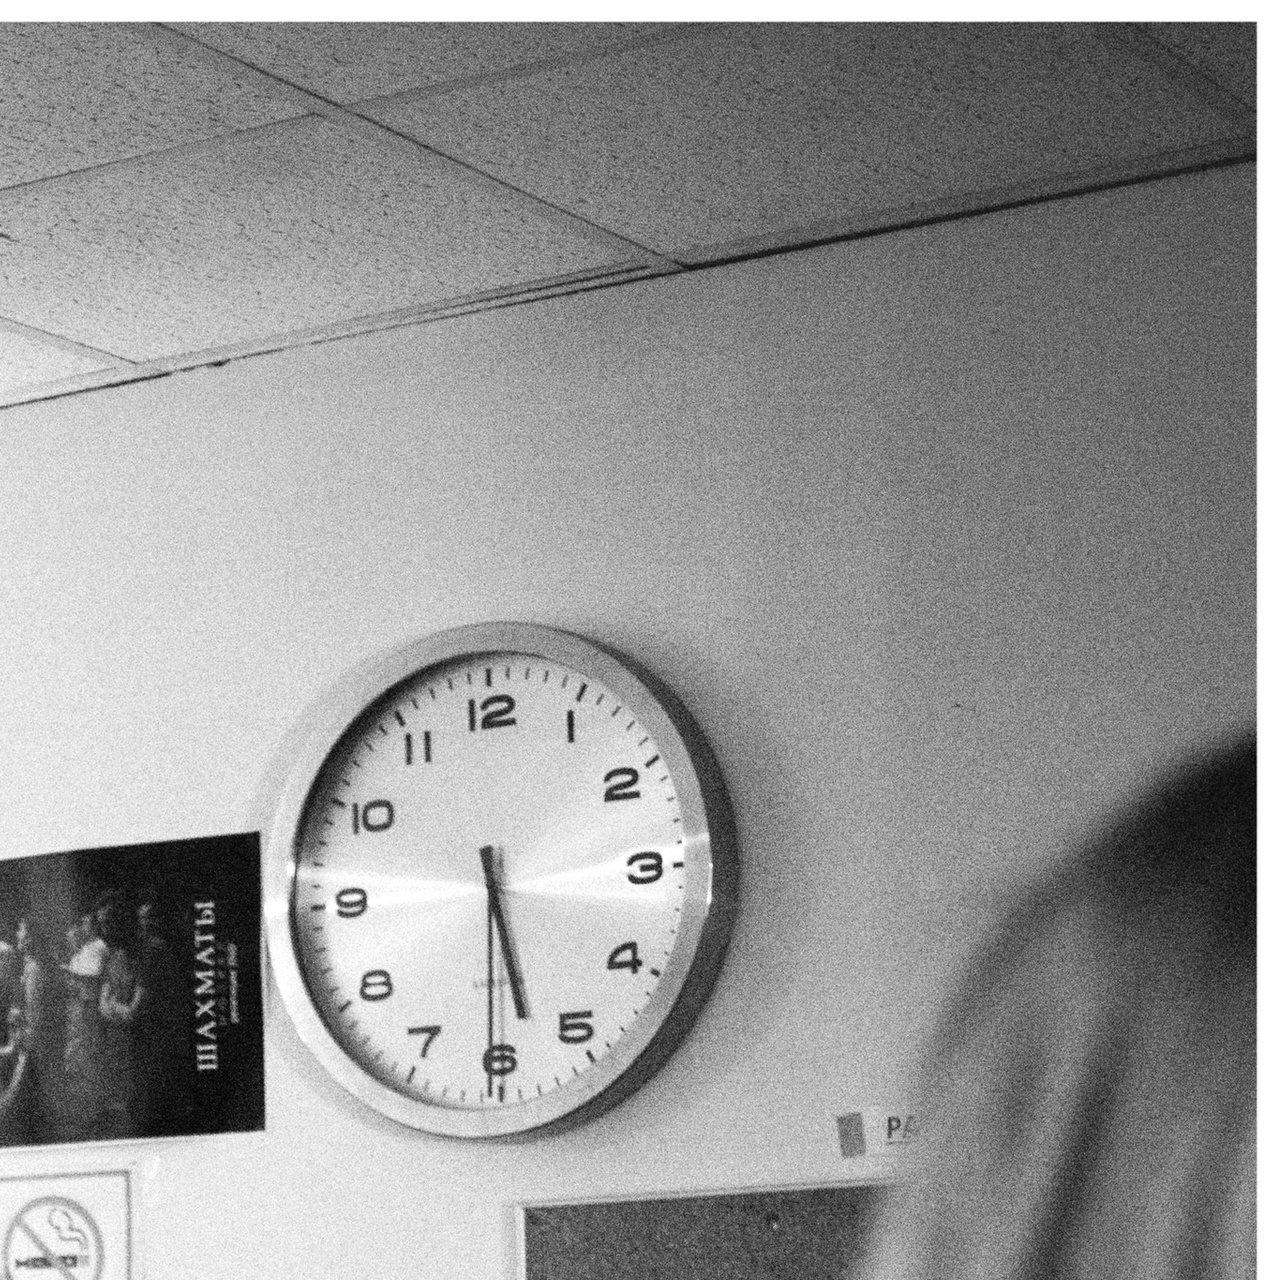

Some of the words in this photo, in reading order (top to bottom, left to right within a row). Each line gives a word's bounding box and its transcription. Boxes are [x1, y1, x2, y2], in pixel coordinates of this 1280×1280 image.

[468, 694, 517, 731] 12
[566, 709, 575, 743] 1
[405, 730, 432, 765] 11
[603, 767, 641, 803] 2
[352, 799, 395, 835] 10
[627, 851, 664, 885] 3
[335, 887, 368, 919] 9
[607, 941, 643, 975] 4
[194, 901, 219, 1071] ШАХМАТЫ
[359, 969, 394, 1002] 8
[407, 1025, 442, 1058] 7
[558, 1010, 595, 1045] 5
[483, 1044, 517, 1076] 6
